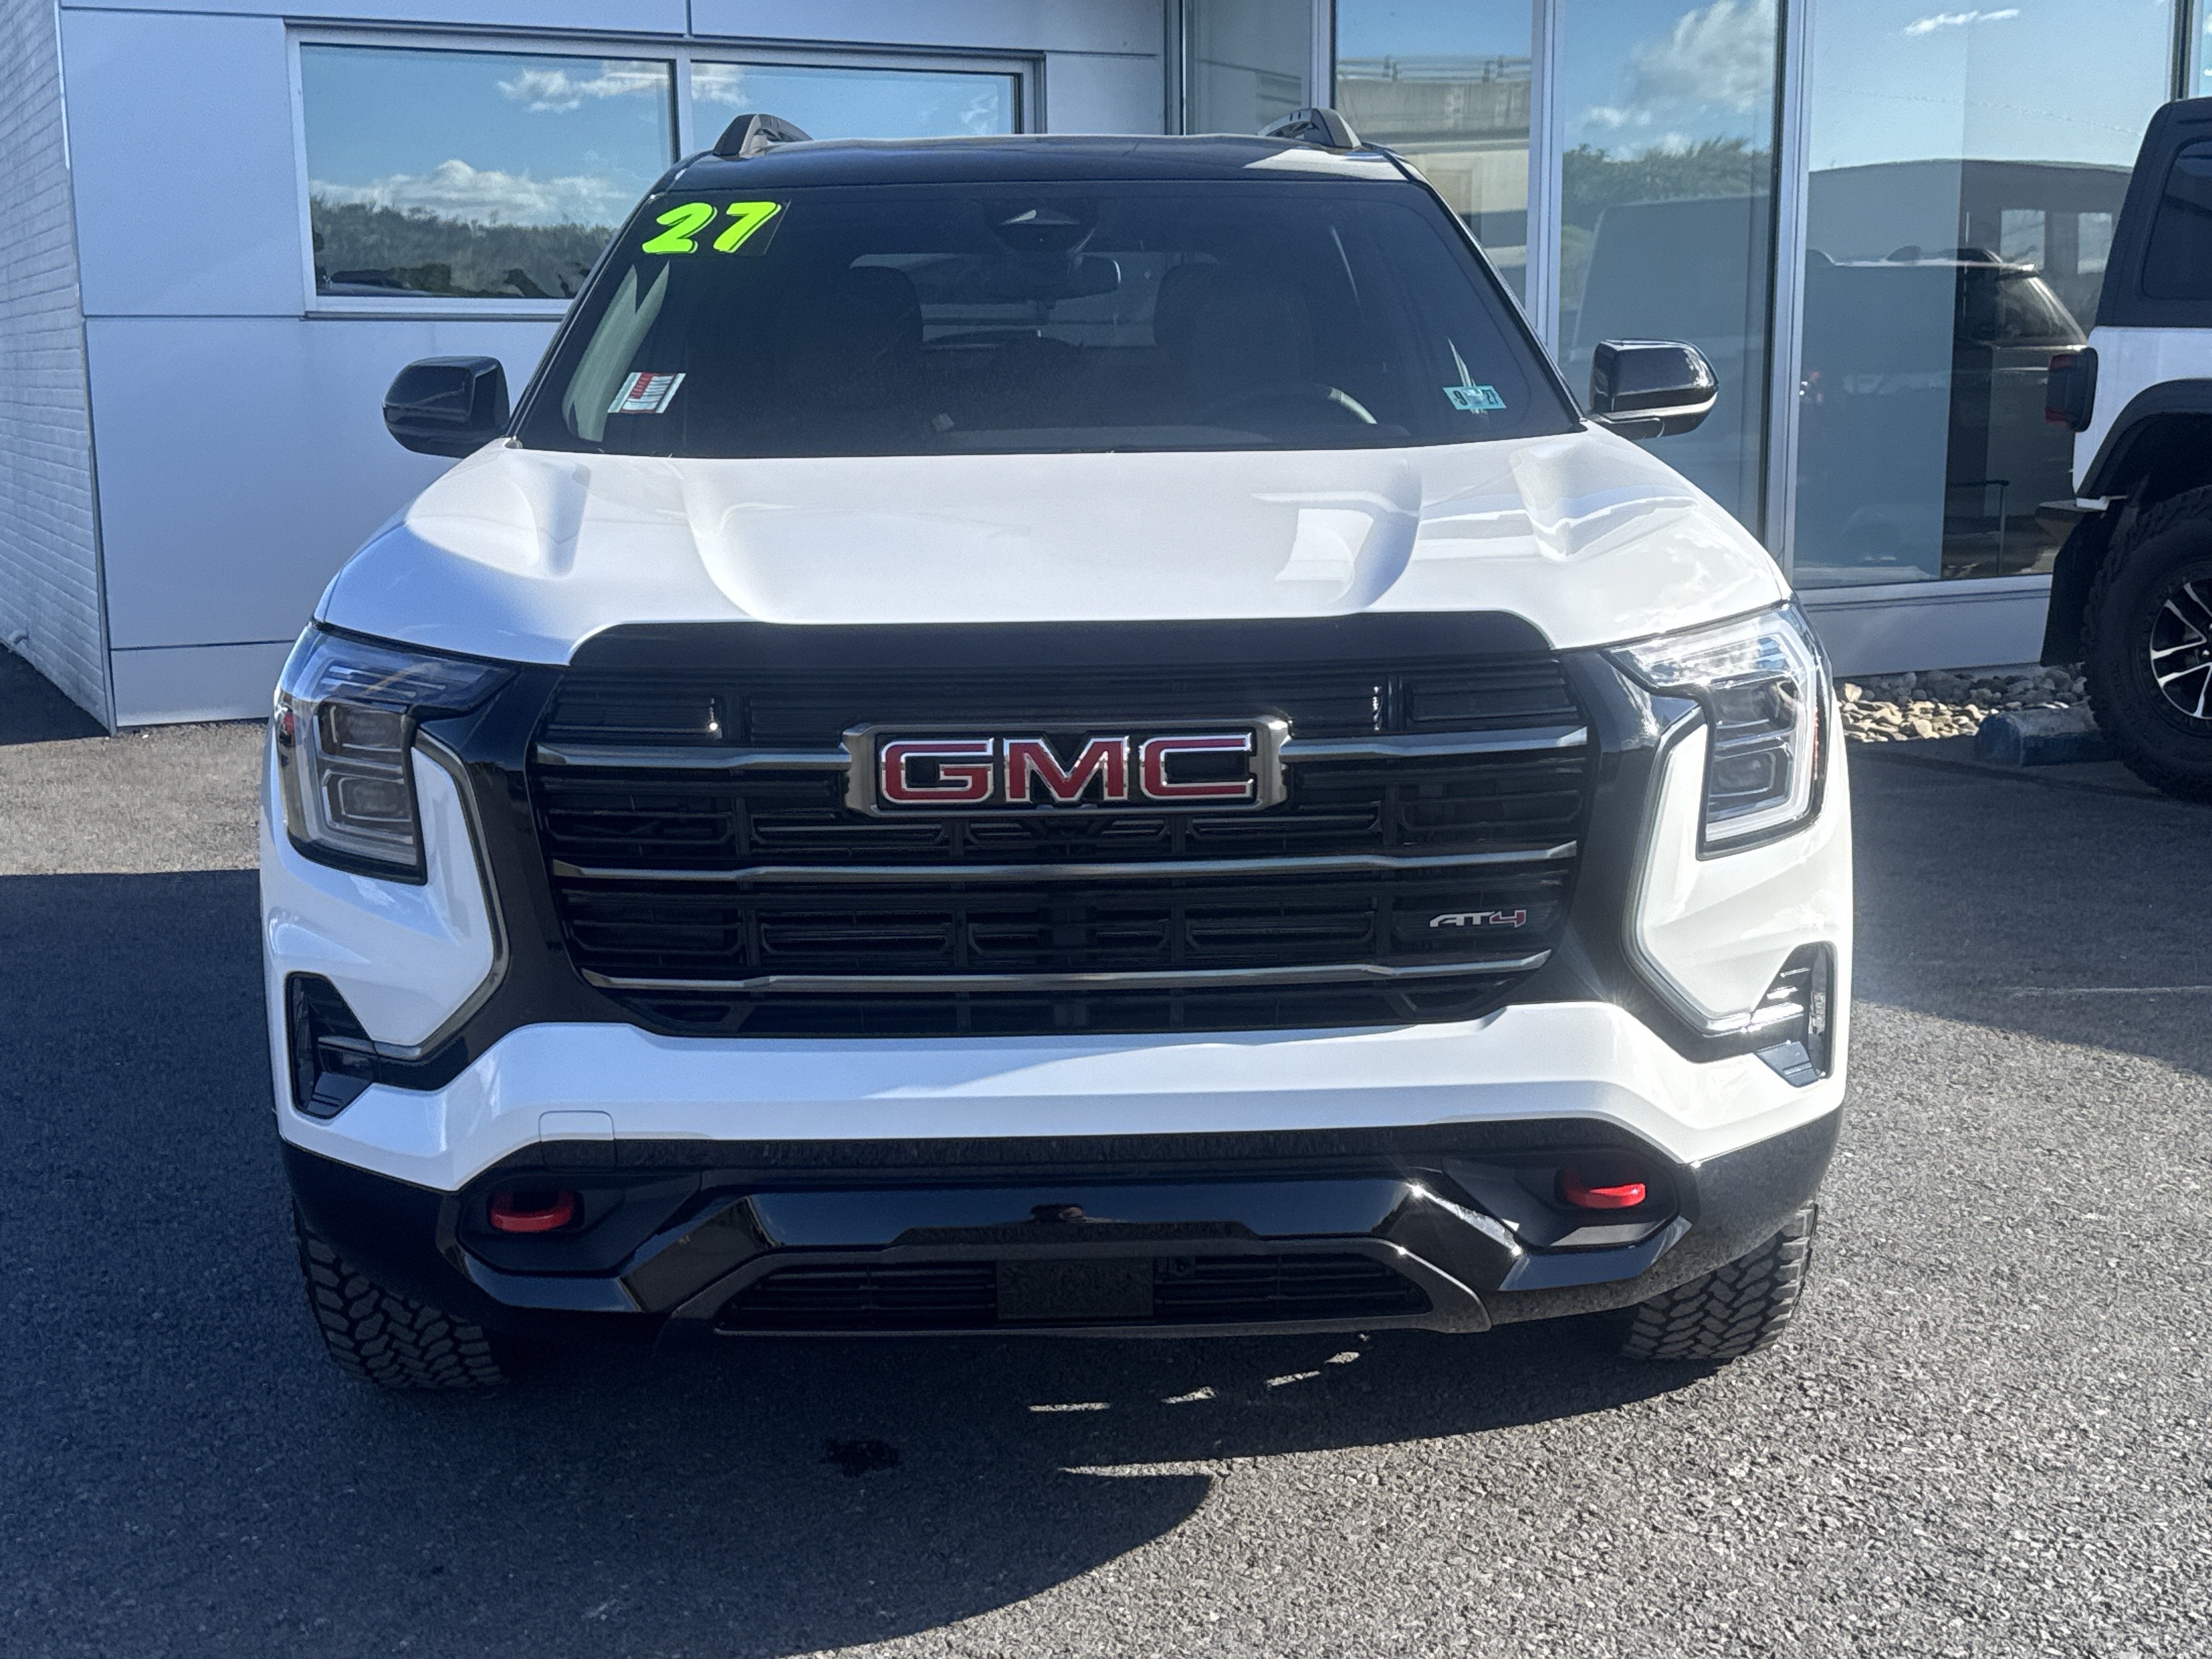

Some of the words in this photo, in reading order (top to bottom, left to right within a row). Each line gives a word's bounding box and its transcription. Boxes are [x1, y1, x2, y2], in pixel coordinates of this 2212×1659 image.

[642, 202, 781, 254] 27
[880, 734, 1253, 804] GMC
[1429, 909, 1527, 928] AT4
